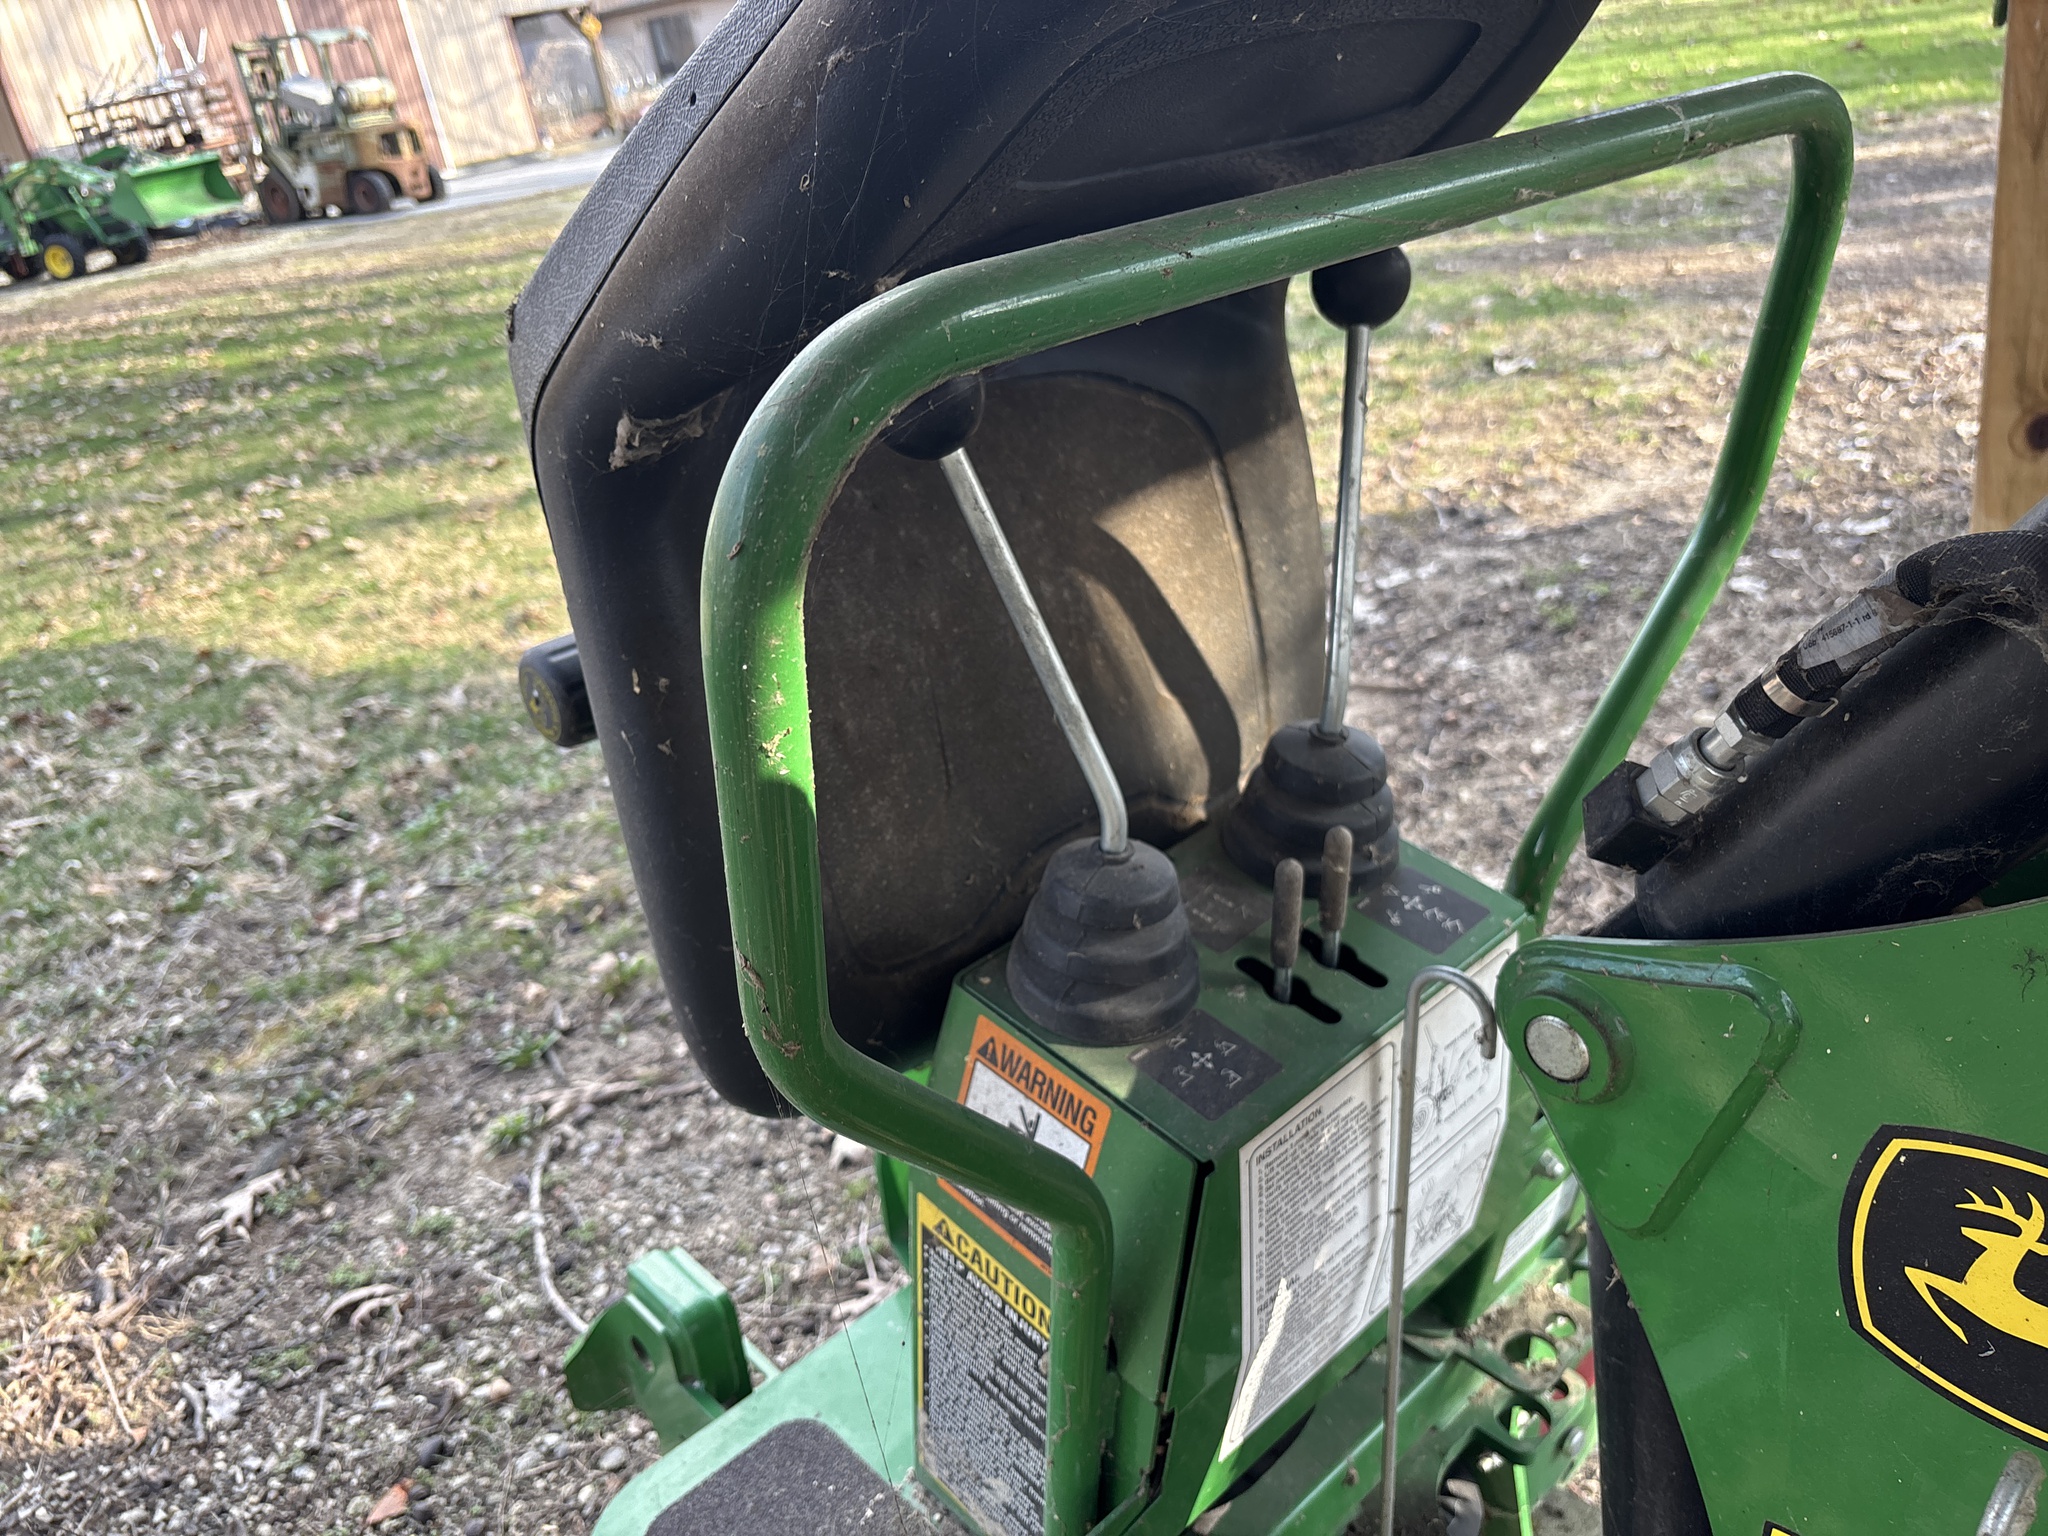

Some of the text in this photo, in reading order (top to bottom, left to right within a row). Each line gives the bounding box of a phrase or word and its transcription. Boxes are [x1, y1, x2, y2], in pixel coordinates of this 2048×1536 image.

[1001, 1042, 1098, 1137] WARNING
[1256, 1106, 1322, 1166] INSTALLATION
[957, 1233, 1050, 1334] CAUTION
[966, 1271, 1003, 1309] AVOID
[1004, 1303, 1049, 1351] INJURY
